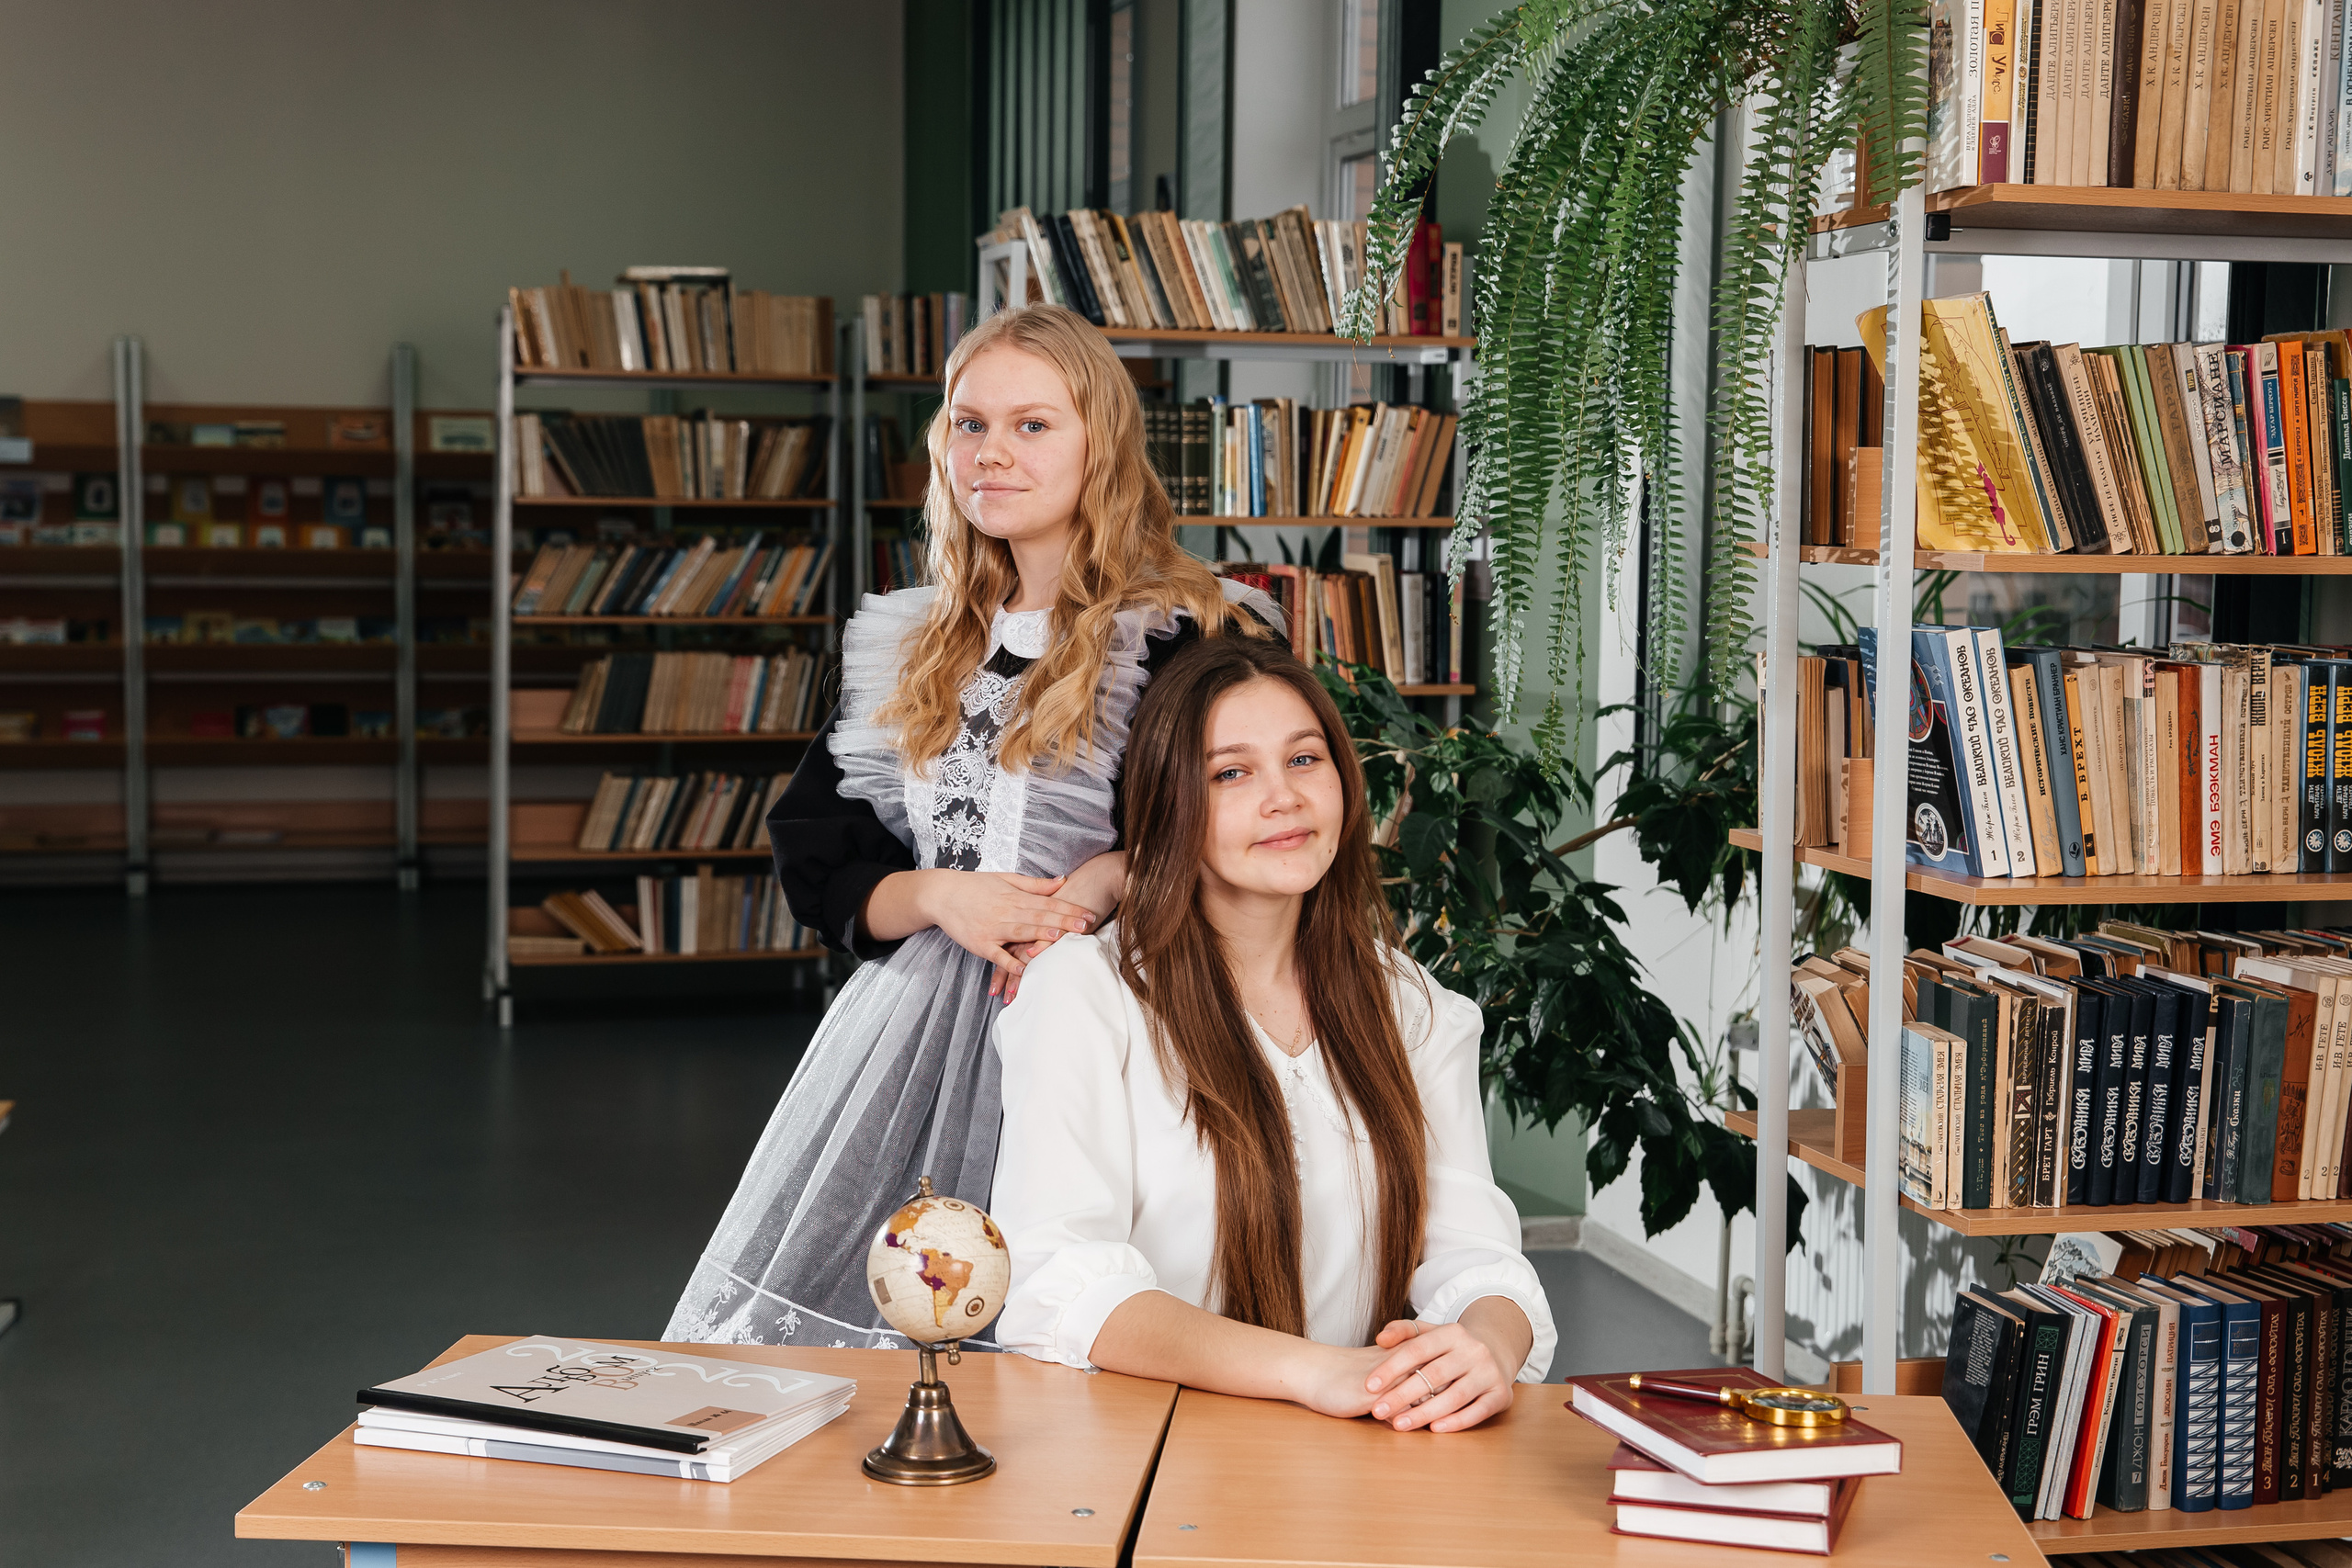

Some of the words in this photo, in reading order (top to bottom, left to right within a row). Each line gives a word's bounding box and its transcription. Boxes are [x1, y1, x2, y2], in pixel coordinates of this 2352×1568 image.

[2148, 3, 2162, 62] АНДЕРСЕН
[2173, 3, 2187, 62] АНДЕРСЕН
[2197, 6, 2211, 65] АНДЕРСЕН
[2222, 5, 2234, 65] АНДЕРСЕН
[2248, 18, 2258, 70] АНДЕРСЕН
[2267, 19, 2277, 71] АНДЕРСЕН
[2330, 0, 2343, 61] КЕНТАВ
[2046, 60, 2056, 100] ДАНТЕ
[2063, 60, 2073, 99] ДАНТЕ
[2081, 59, 2091, 99] ДАНТЕ
[2100, 59, 2110, 99] ДАНТЕ
[2327, 108, 2335, 147] АПДАЙК
[2326, 150, 2335, 176] ДЖОН
[1994, 327, 2008, 372] Страны
[2005, 371, 2020, 414] Сказки
[2073, 373, 2094, 445] УТРАЧЕННЫЕ
[2157, 345, 2181, 436] ТАРЗАН
[2267, 381, 2277, 414] БЕРРОУЗ
[2340, 390, 2349, 422] Биссет
[2209, 352, 2233, 467] МАРСИАНЕ
[2342, 422, 2351, 460] Дональд
[2095, 447, 2110, 488] БАЛЬЗАК
[2037, 442, 2067, 533] ТРИДЦАТИЛЕТНЯЯ
[2106, 502, 2120, 528] ОНОРЕ
[1957, 645, 1975, 703] ОКЕАНОВ
[1985, 647, 2004, 705] ОКЕАНОВ
[2049, 662, 2062, 696] БРАННЕР
[2251, 655, 2267, 685] ВЕРН
[2024, 678, 2035, 720] ПОВЕСТИ
[2053, 696, 2065, 736] КРИСТИАН
[2250, 690, 2267, 727] ЖЮЛЬ
[2284, 683, 2293, 715] ОСТРОВ
[2308, 684, 2328, 724] ВЕРН
[2335, 685, 2352, 724] ВЕРН
[1964, 705, 1977, 733] ЧАС
[1993, 708, 2007, 736] ЧАС
[1968, 734, 1987, 788] ВЕЛИКИЙ
[1996, 736, 2016, 790] ВЕЛИКИЙ
[2030, 723, 2047, 797] ИСТОРИЧЕСКИЕ
[2059, 736, 2068, 757] ХАНС
[2073, 727, 2088, 784] БРЕХТ
[2117, 733, 2125, 773] ШАРЛОТТА
[2279, 718, 2292, 793] ТАИНСТВЕННЫЙ
[2307, 728, 2326, 779] ЖЮЛЬ
[2335, 729, 2352, 779] ЖЮЛЬ
[2209, 734, 2221, 813] БЭЭКМАН
[2080, 790, 2089, 803] Б.
[2307, 784, 2315, 805] ДЕТИ
[2312, 784, 2321, 819] КАПИТАНА
[2335, 784, 2344, 805] ДЕТИ
[2281, 805, 2290, 827] ВЕРН
[1990, 850, 1997, 862] 1
[2210, 819, 2221, 856] ЭМЭ
[2280, 827, 2290, 853] ЖЮЛЬ
[2017, 851, 2026, 863] 2
[2025, 1006, 2033, 1038] ДЕТЕКТИВ
[2317, 1023, 2329, 1049] ГЕТЕ
[2335, 1021, 2347, 1047] ГЕТЕ
[1936, 1051, 1946, 1072] ЗМЕЯ
[1954, 1052, 1964, 1073] ЗМЕЯ
[2021, 1037, 2030, 1084] ЗАРУБЕЖНЫЙ
[2048, 1030, 2059, 1065] Конрой
[2077, 1038, 2096, 1073] МИРА
[2109, 1033, 2125, 1069] МИРА
[2131, 1034, 2147, 1070] МИРА
[2154, 1033, 2174, 1069] МИРА
[2189, 1036, 2206, 1072] МИРА
[1936, 1073, 1946, 1111] СТАЛЬНАЯ
[1953, 1074, 1963, 1111] СТАЛЬНАЯ
[2045, 1066, 2057, 1107] Гэбриель
[2229, 1089, 2242, 1128] Сказки
[2043, 1127, 2053, 1153] ГАРТ
[2199, 1126, 2207, 1154] СКАЗКИ
[2041, 1155, 2052, 1182] БРЕТ
[2303, 1169, 2311, 1180] 2
[2321, 1166, 2328, 1177] 2
[2333, 1166, 2340, 1177] 2
[2268, 1313, 2279, 1366] ФОРСАЙТАХ
[2294, 1311, 2305, 1365] ФОРСАЙТАХ
[2318, 1310, 2329, 1363] ФОРСАЙТАХ
[2330, 1307, 2341, 1360] ФОРСАЙТАХ
[505, 1344, 816, 1394] 2022
[2033, 1353, 2050, 1393] ГРИН
[2103, 1382, 2115, 1416] Короли
[2110, 1357, 2120, 1380] ночи
[2135, 1325, 2152, 1419] ГОЛСУОРСИ
[2267, 1371, 2277, 1396] САГА
[2293, 1368, 2302, 1392] САГА
[2315, 1366, 2325, 1391] САГА
[2327, 1364, 2337, 1388] САГА
[2163, 1379, 2172, 1417] ДЖОСЛИН
[2338, 1381, 2352, 1438] КАРЛО
[2026, 1399, 2043, 1436] ГРЭМ
[2132, 1426, 2144, 1470] ДЖОН
[2159, 1432, 2170, 1468] Голсуорси
[2134, 1472, 2141, 1483] 7
[2159, 1469, 2168, 1492] Джон
[2263, 1476, 2272, 1490] 3
[2290, 1473, 2299, 1488] 2
[2312, 1473, 2319, 1487] 1
[2323, 1470, 2331, 1483] 4
